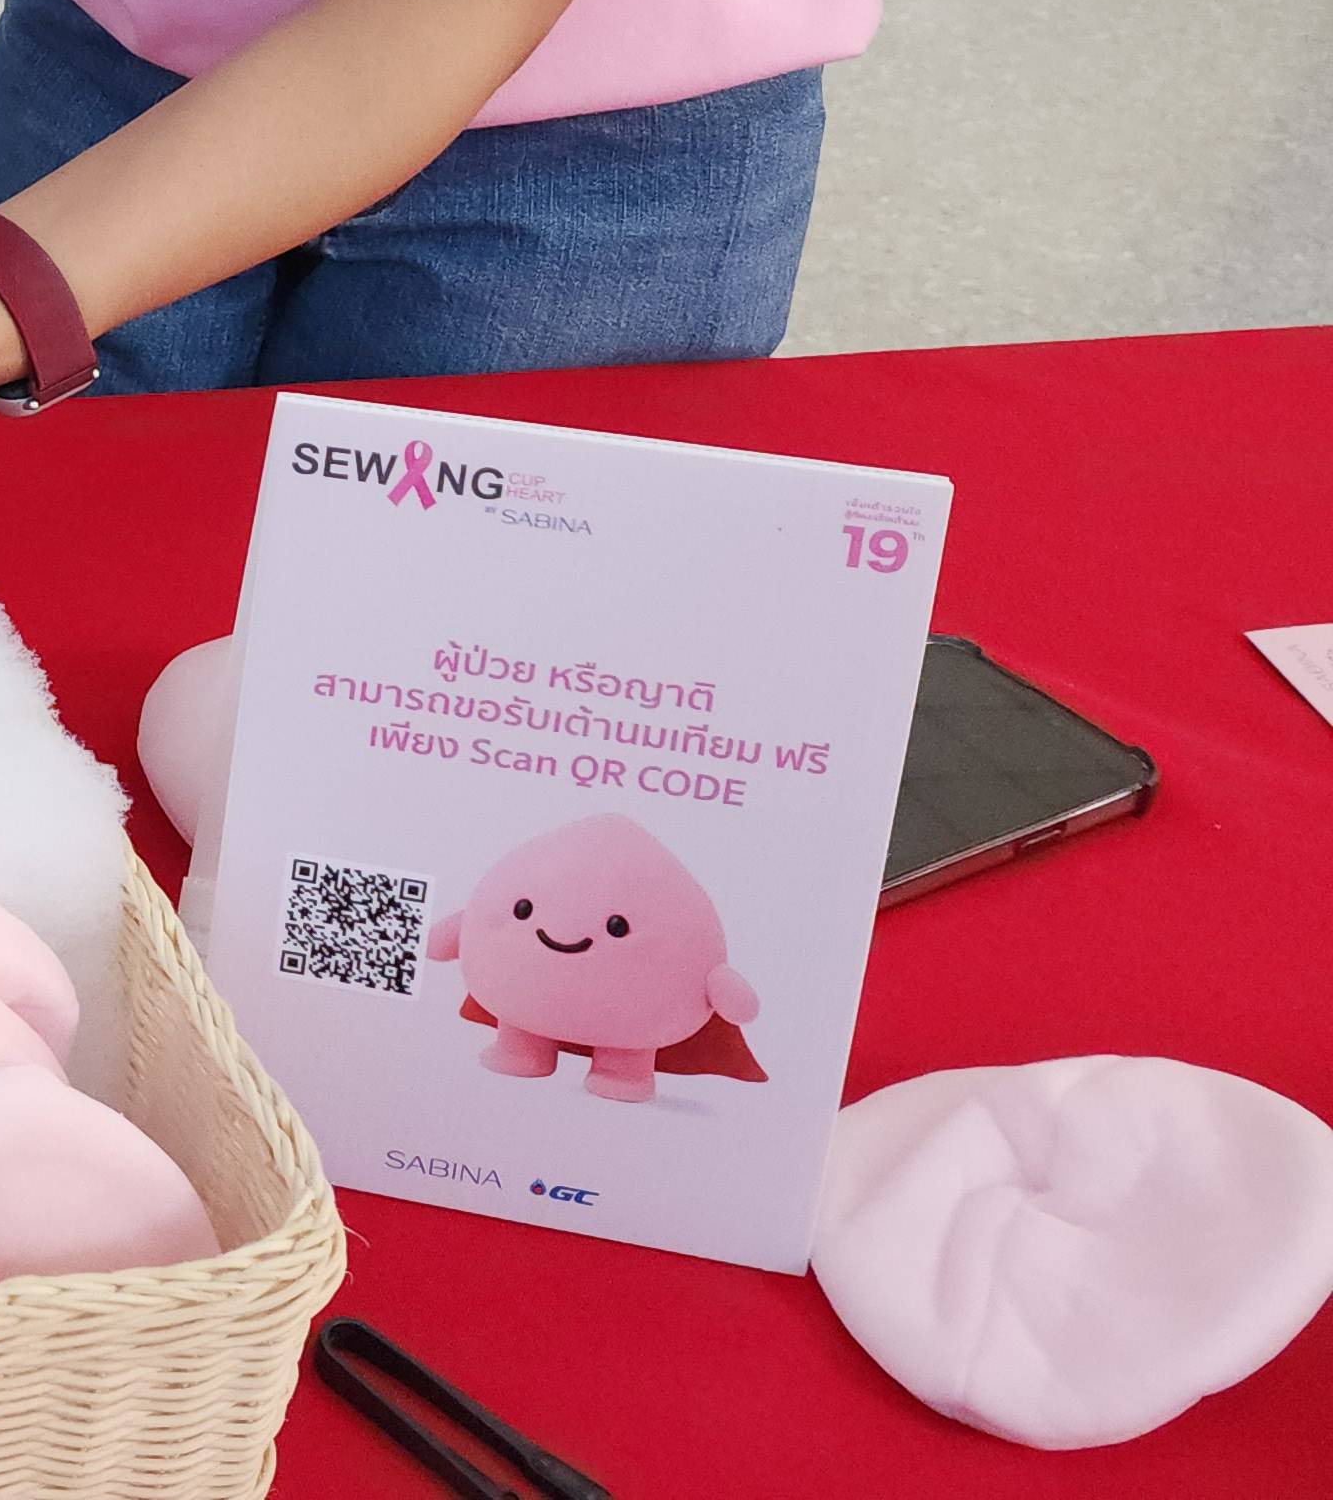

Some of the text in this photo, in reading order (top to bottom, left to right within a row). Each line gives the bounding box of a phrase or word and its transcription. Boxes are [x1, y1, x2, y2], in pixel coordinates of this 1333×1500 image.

[506, 486, 566, 505] HEART
[508, 472, 546, 487] CUP
[501, 508, 593, 535] SABINA
[842, 525, 909, 574] 19
[433, 640, 717, 712] ผู้ป่วย หรือญาติ
[313, 672, 831, 776] สามารถขอรับเต้านมเทียม ฟรี
[369, 721, 748, 808] เพียง Scan QR CODE
[384, 1149, 601, 1207] SABINA GC
